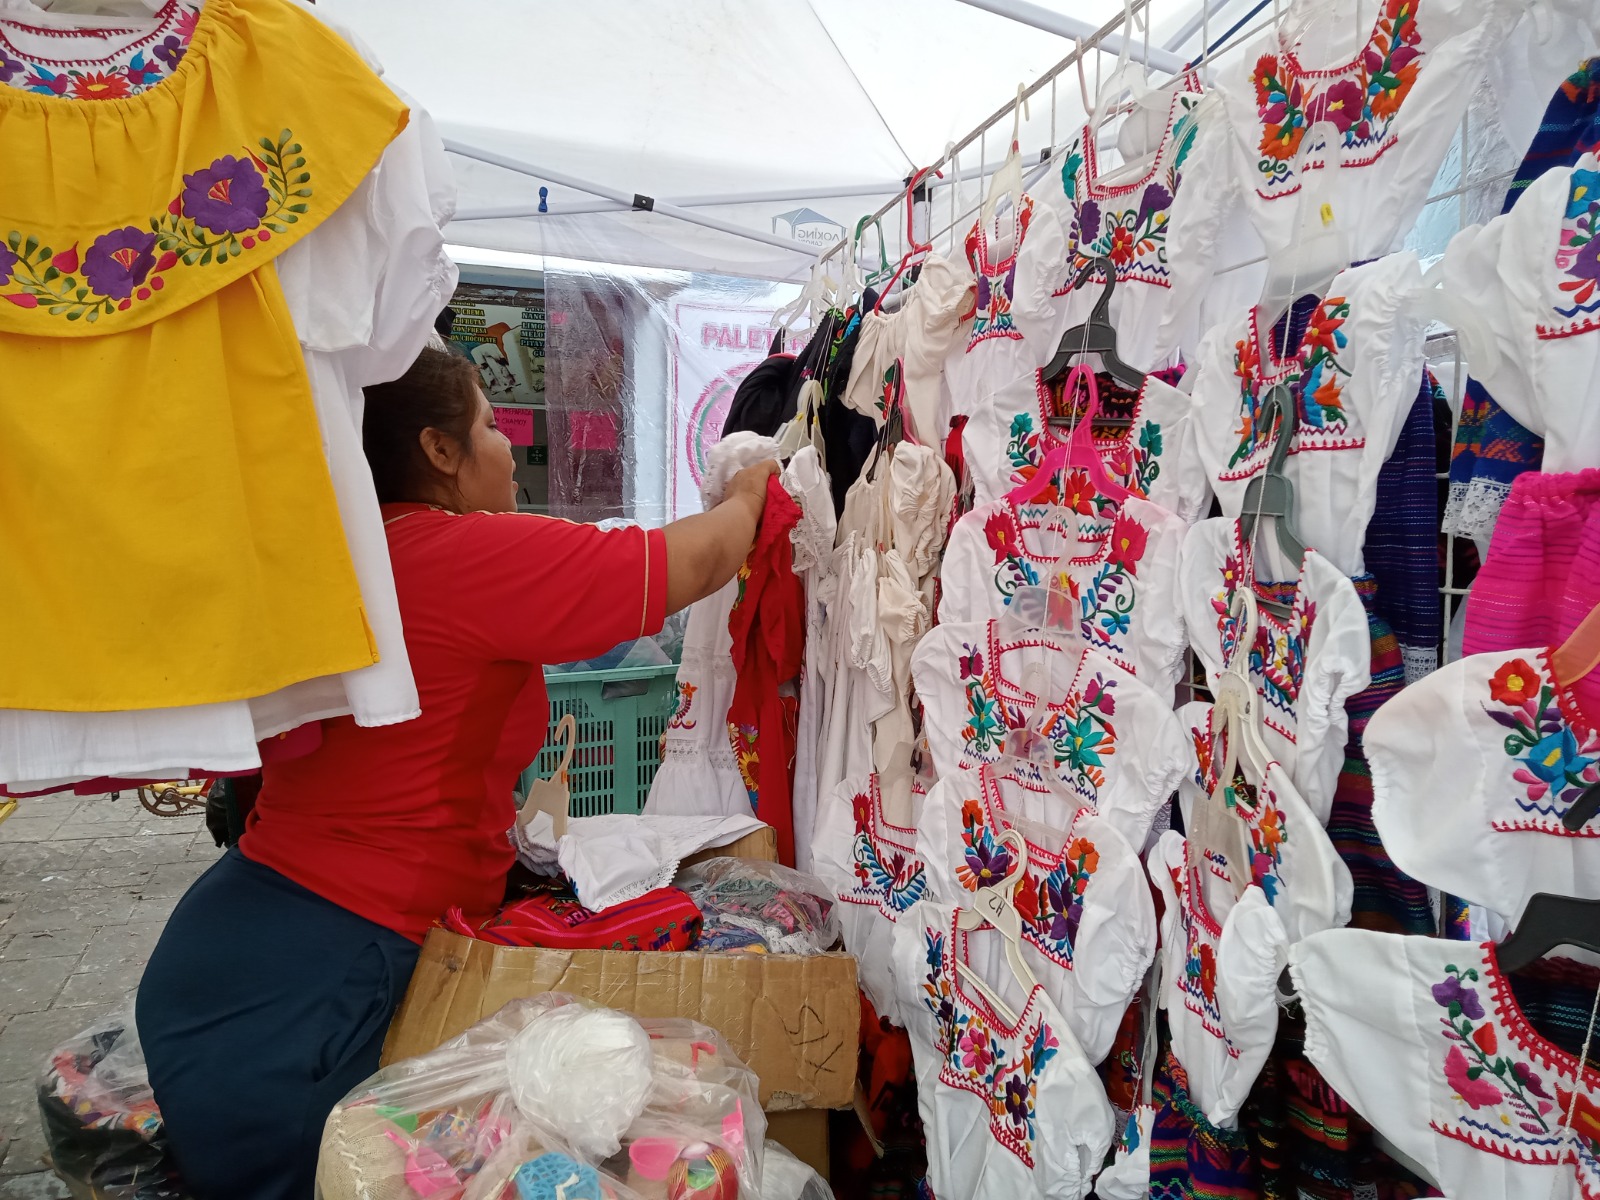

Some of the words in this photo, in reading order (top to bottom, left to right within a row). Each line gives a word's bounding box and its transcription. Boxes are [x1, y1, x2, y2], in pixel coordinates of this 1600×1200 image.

[462, 308, 485, 316] CREMA
[522, 312, 545, 320] NANC
[461, 318, 486, 326] FRUTAS
[520, 330, 545, 338] MELO
[461, 335, 497, 344] CHOCOLATE
[520, 339, 545, 348] PITAY
